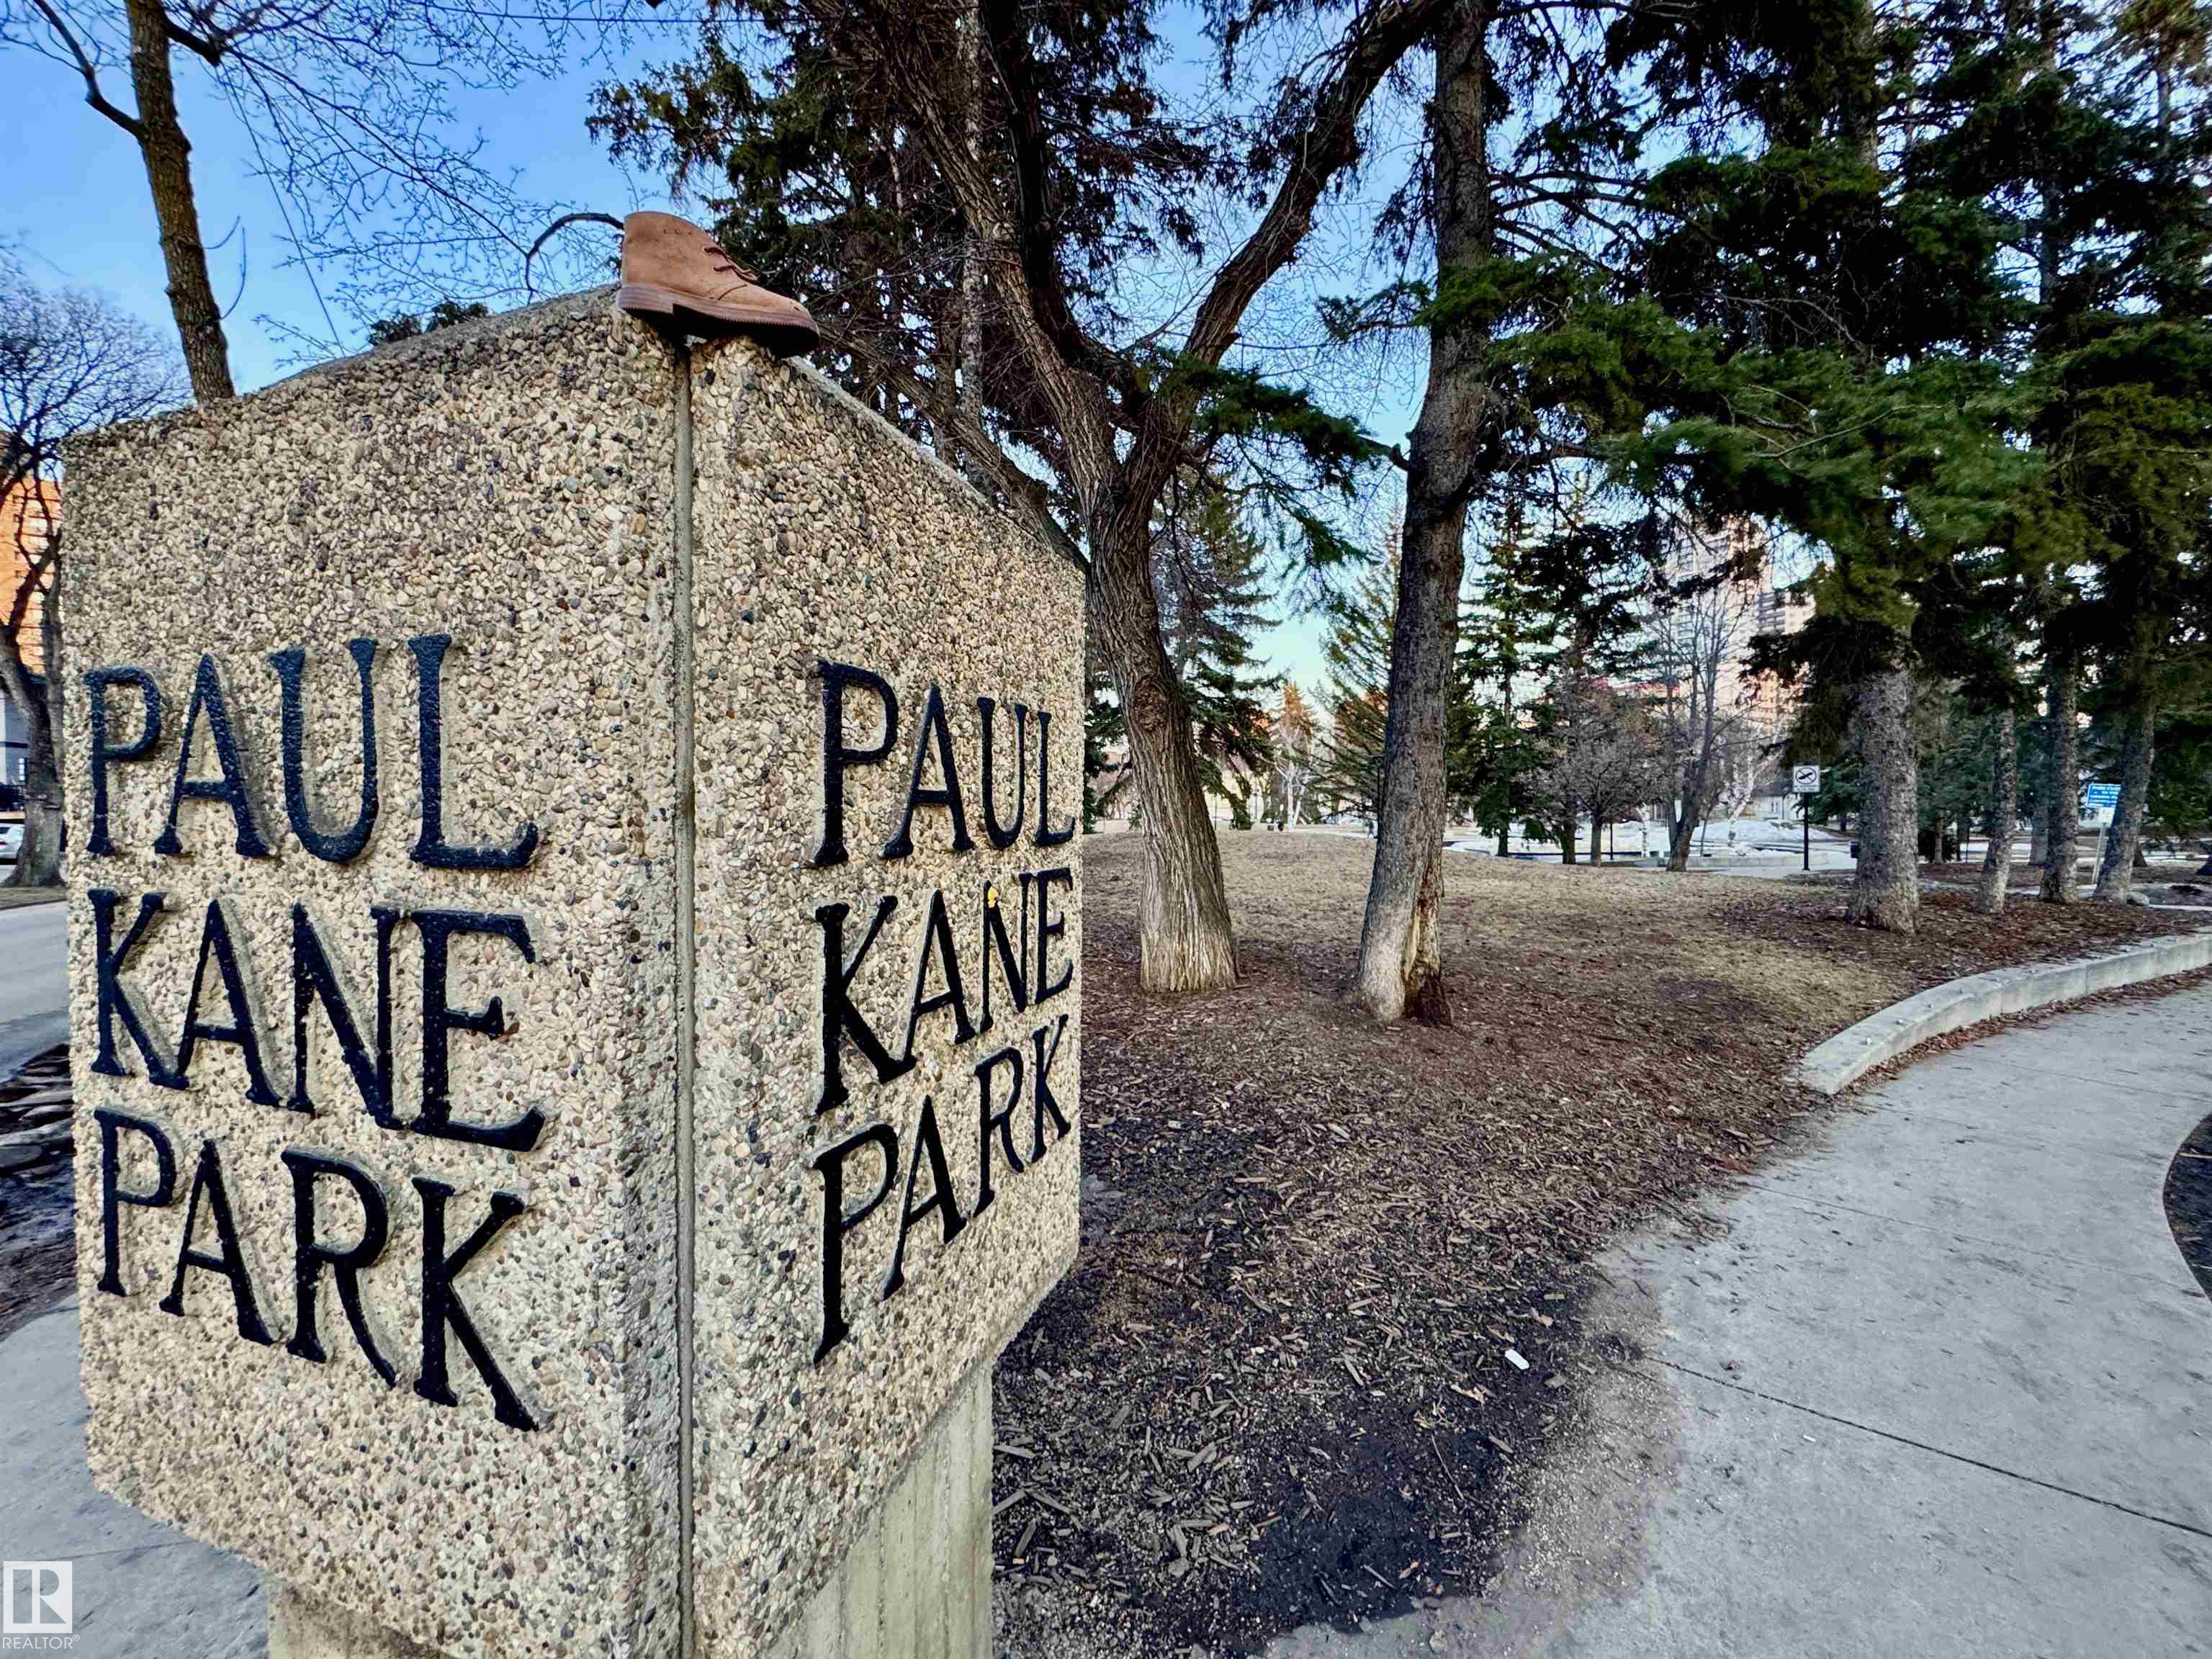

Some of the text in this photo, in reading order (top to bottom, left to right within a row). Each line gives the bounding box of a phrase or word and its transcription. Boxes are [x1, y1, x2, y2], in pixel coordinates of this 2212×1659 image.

[83, 633, 539, 870] PAUL
[815, 657, 1076, 865] PAUL
[88, 888, 545, 1152] KANE
[815, 867, 1074, 1116] KANE
[94, 1107, 540, 1431] PARK
[814, 1014, 1071, 1366] PARK
